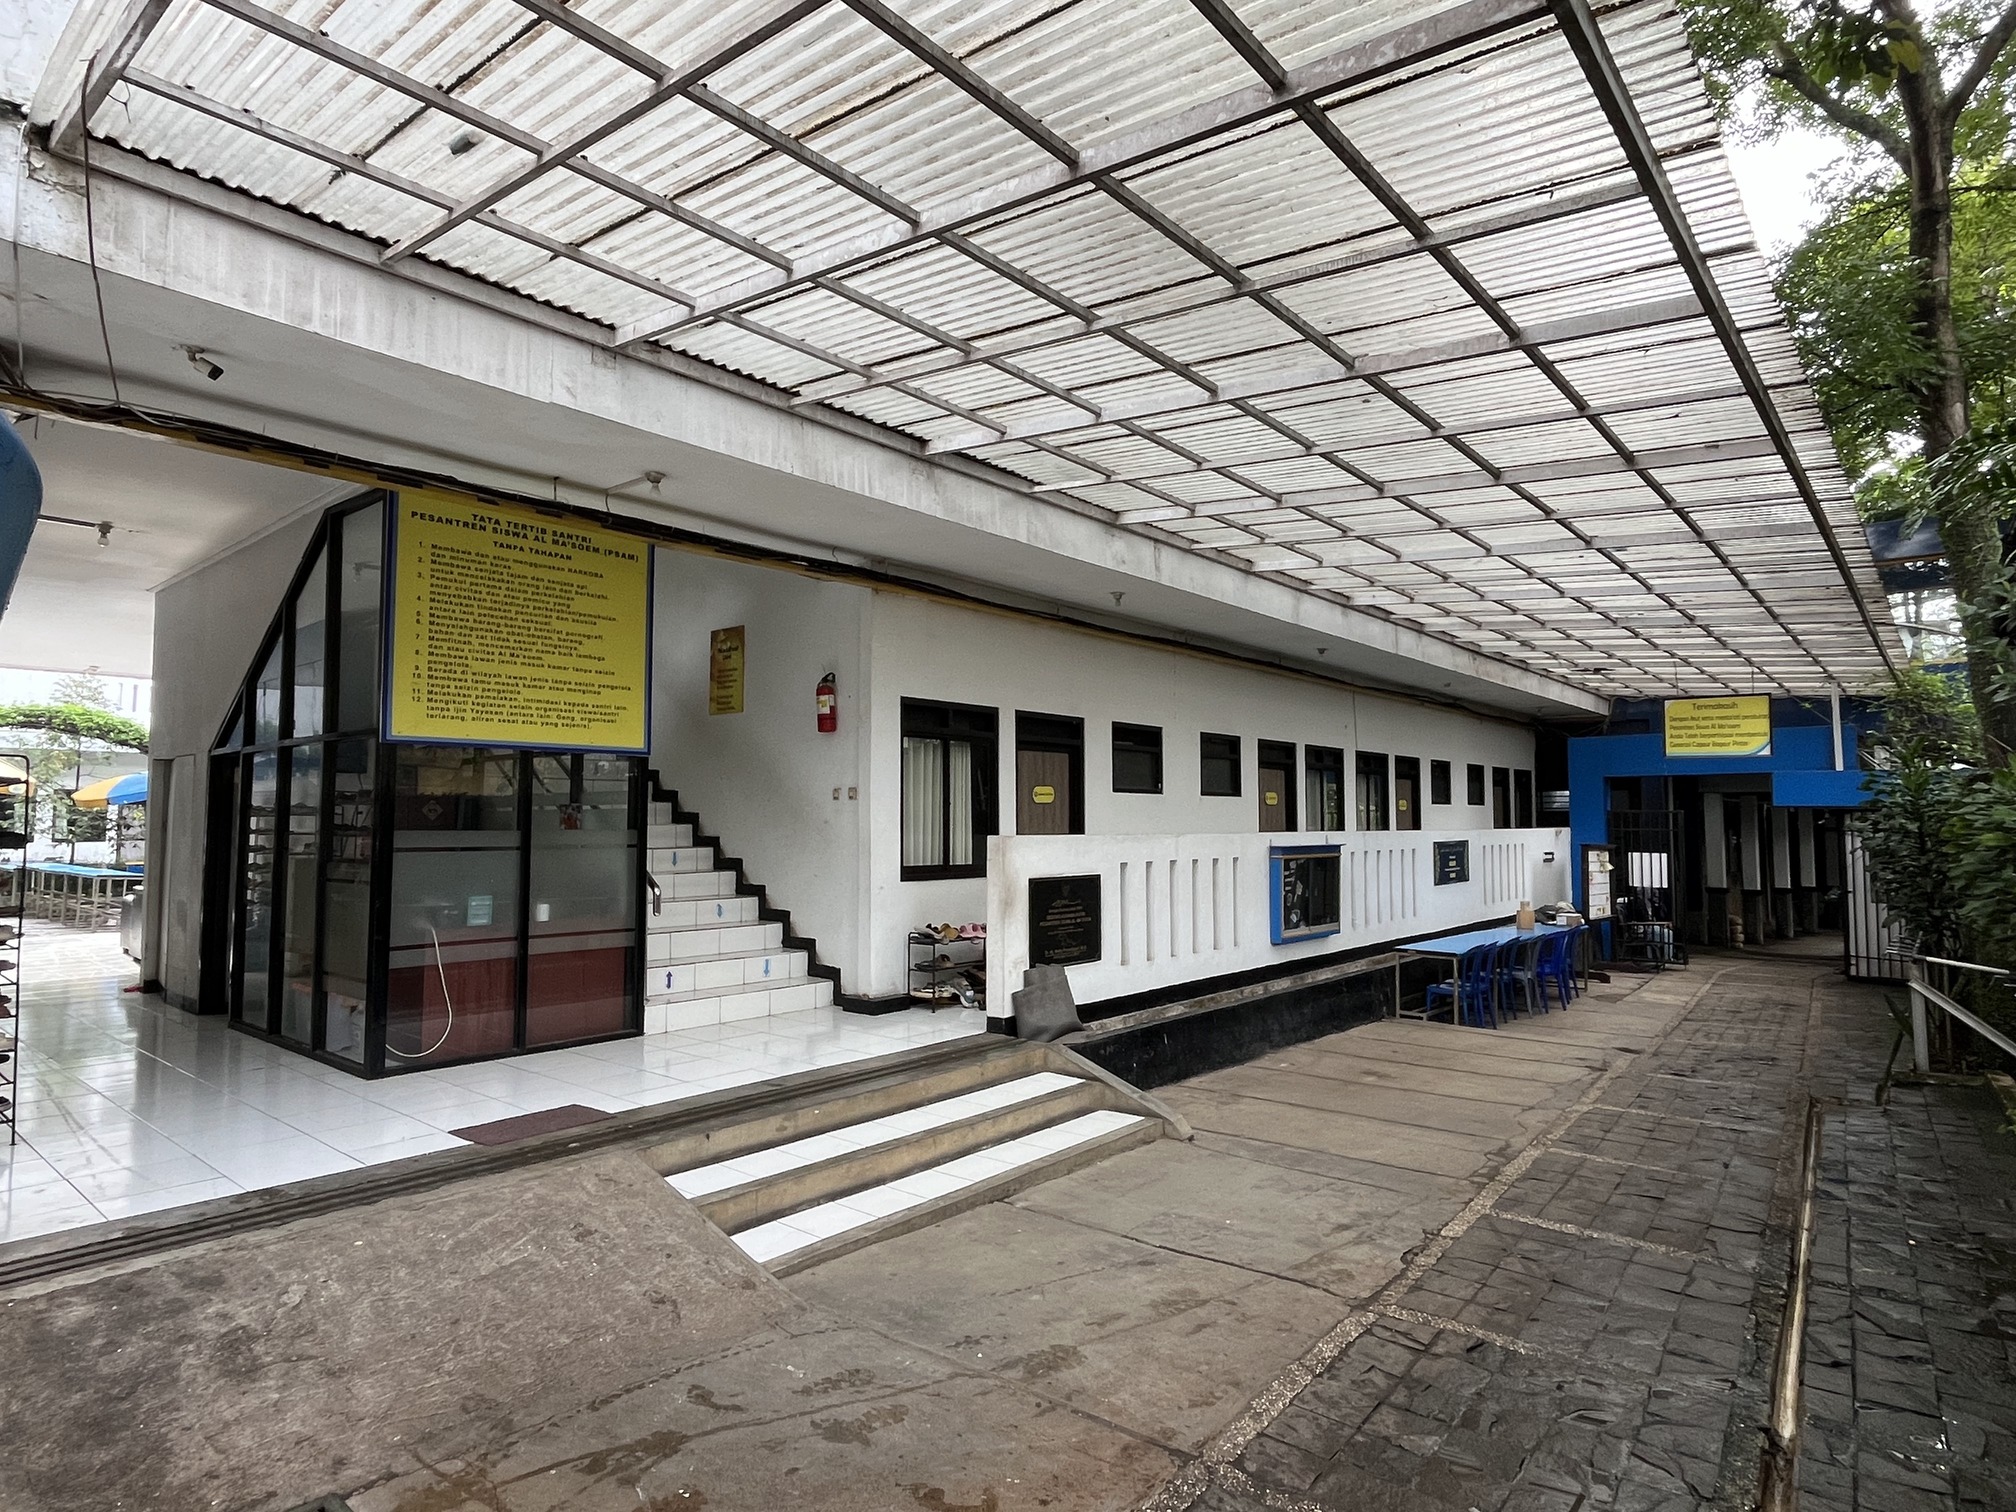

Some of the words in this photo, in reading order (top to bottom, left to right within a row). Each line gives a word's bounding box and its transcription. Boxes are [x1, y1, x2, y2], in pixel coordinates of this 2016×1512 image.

[410, 510, 487, 533] PESANTREN
[491, 526, 529, 541] SISWA
[533, 534, 547, 544] AL
[551, 538, 600, 555] MA'SOEM
[604, 548, 639, 563] (PSAM)
[471, 513, 501, 526] TATA
[506, 520, 547, 536] TERTIB
[552, 530, 592, 545] SANTRI
[430, 550, 447, 559] dan
[449, 554, 490, 566] minuman
[492, 540, 525, 552] TANPA
[528, 547, 572, 561] TAHAPAN
[431, 543, 472, 556] Membawa
[474, 551, 490, 559] dan
[567, 567, 604, 579] NARKOBA
[430, 558, 472, 571] Membawa
[506, 571, 528, 582] tajam
[530, 575, 545, 583] dan
[430, 566, 454, 576] untuk
[430, 574, 467, 586] Pemukul
[505, 586, 529, 595] dalam
[429, 589, 487, 605] menyebabkan
[429, 597, 474, 609] Melakukan
[454, 585, 483, 595] civitas
[486, 590, 500, 598] dan
[552, 602, 571, 610] yang
[429, 612, 470, 623] Membawa
[459, 608, 475, 616] lain
[428, 627, 455, 637] bahan
[490, 635, 511, 643] tidak
[427, 651, 469, 661] Membawa
[471, 655, 496, 664] lawan
[497, 658, 518, 667] jenis
[520, 661, 545, 669] masuk
[427, 666, 458, 675] Berada
[471, 670, 502, 680] wilayah
[530, 676, 549, 685] jenis
[551, 678, 572, 687] tanpa
[427, 674, 468, 683] Membawa
[426, 682, 451, 691] tanpa
[427, 689, 472, 699] Melakukan
[426, 697, 469, 708] Mengikuti
[471, 700, 506, 710] kegiatan
[426, 705, 451, 714] tanpa
[453, 707, 467, 715] ijin
[1692, 702, 1739, 711] Terimakasih
